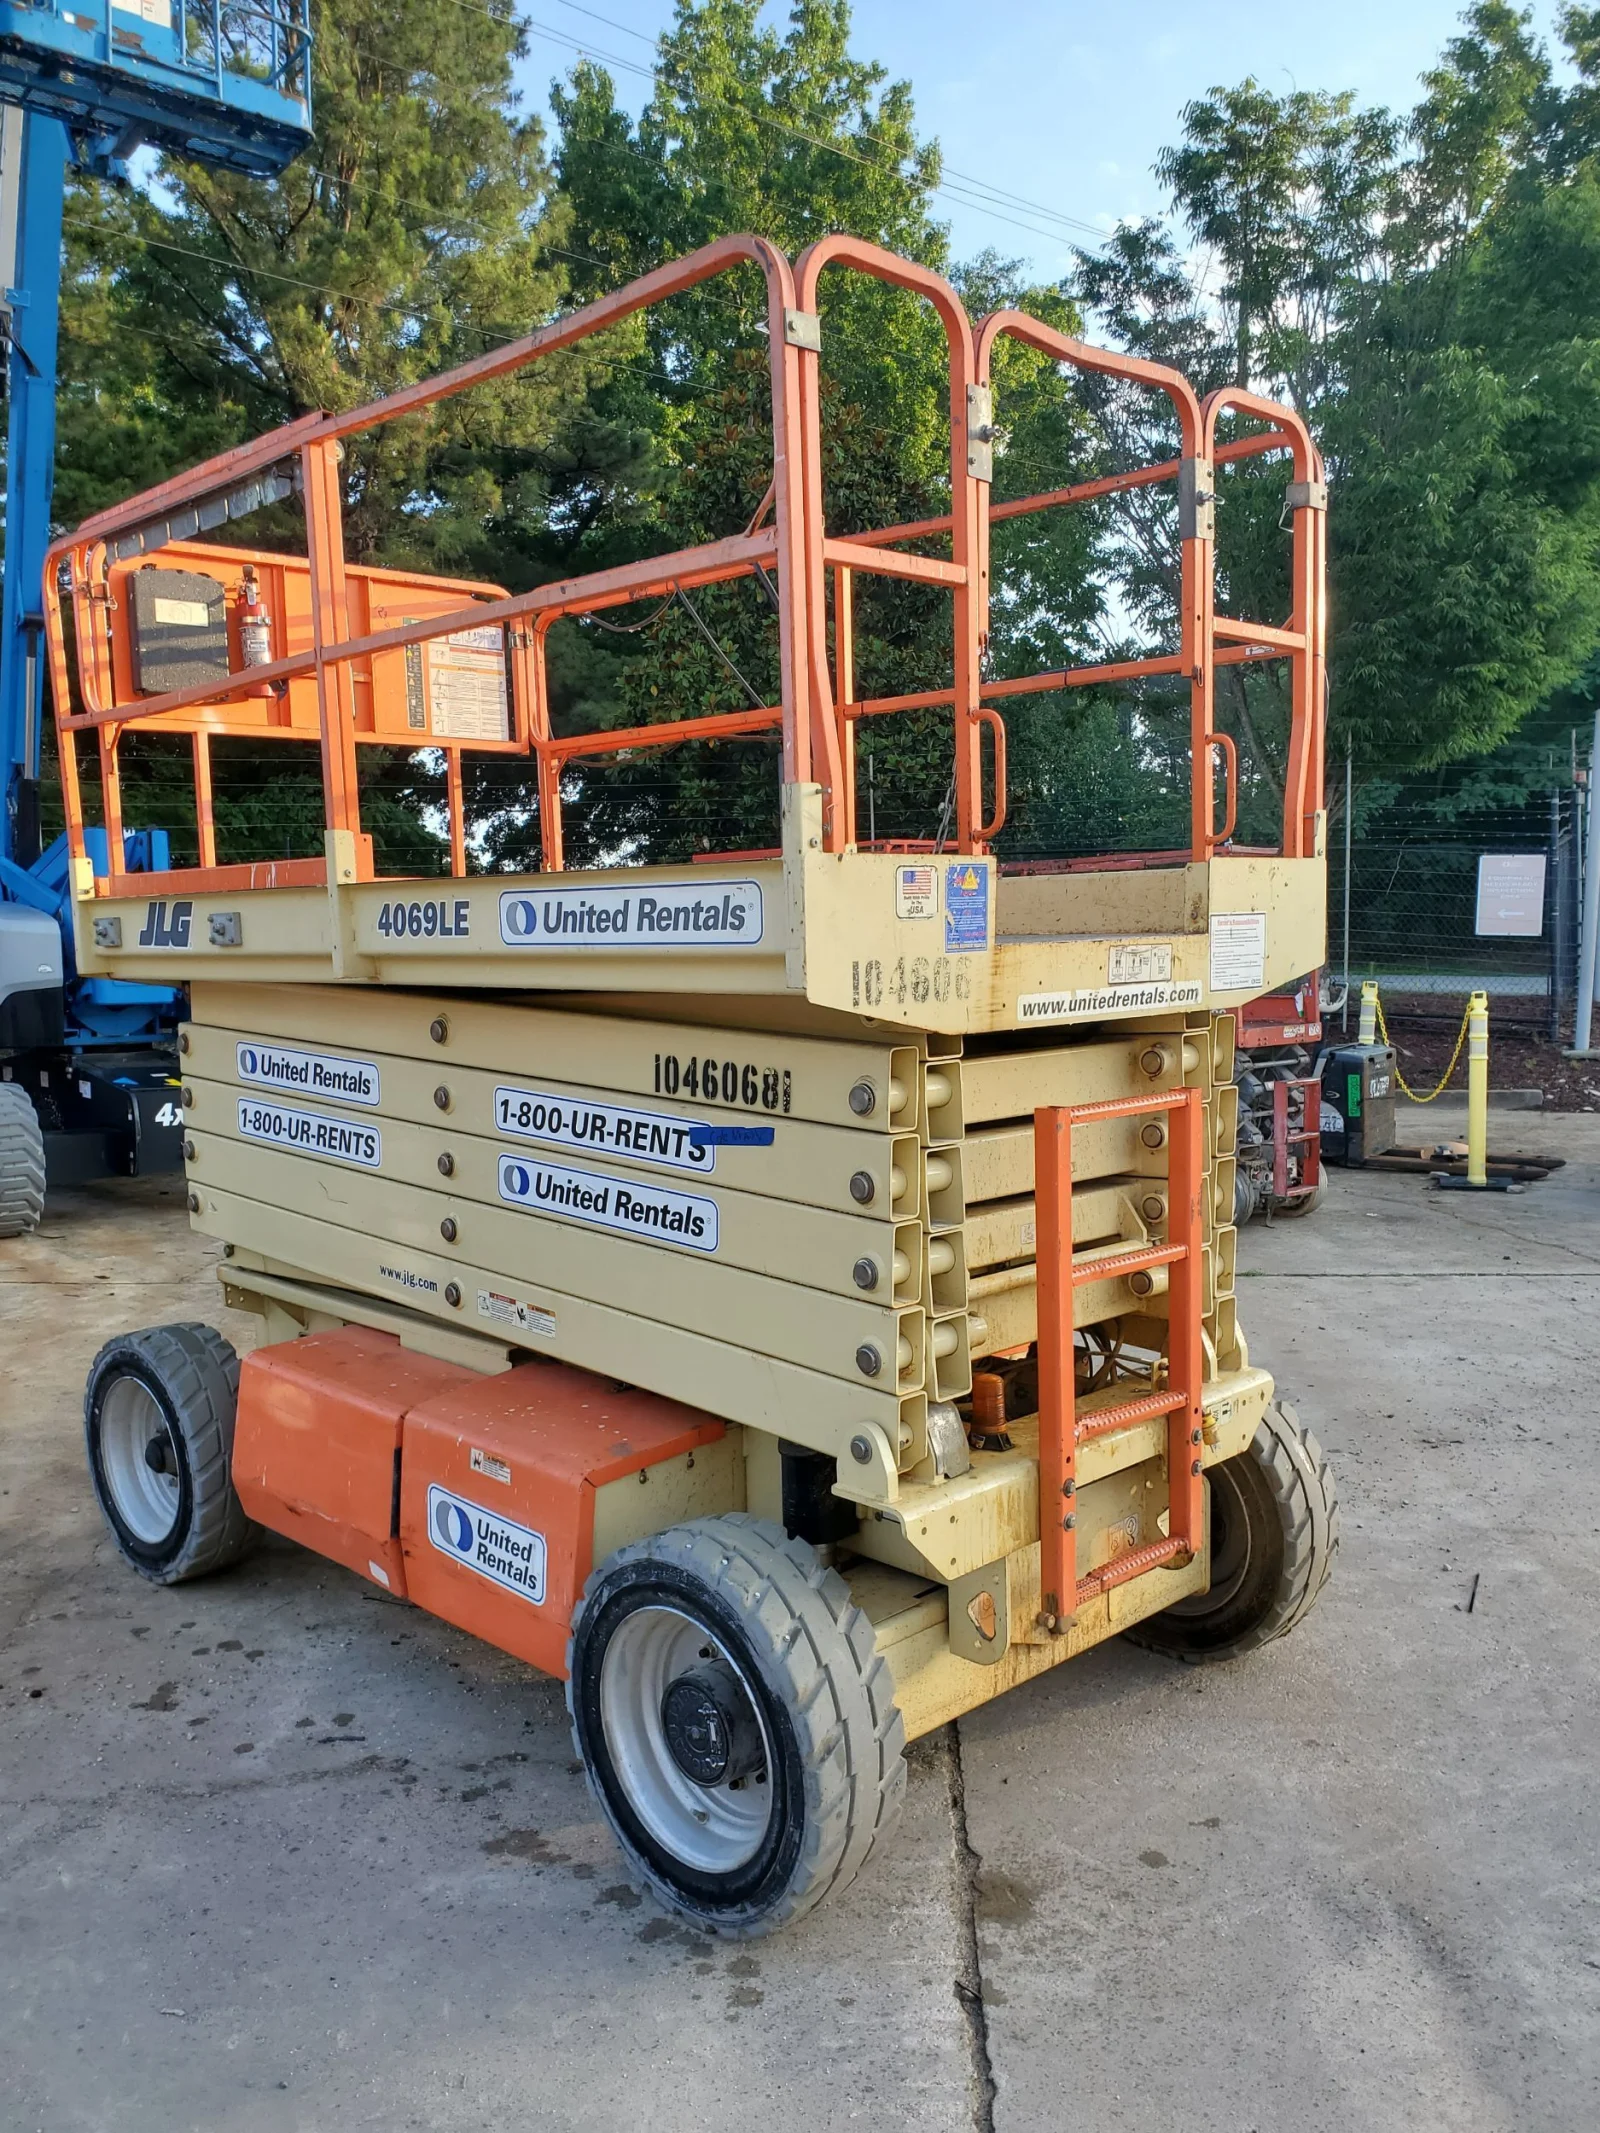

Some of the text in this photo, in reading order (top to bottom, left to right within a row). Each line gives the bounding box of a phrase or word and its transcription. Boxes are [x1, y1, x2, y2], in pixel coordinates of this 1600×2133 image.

[138, 901, 194, 948] JLG
[377, 900, 470, 938] 4069LE
[543, 894, 746, 934] United Rentals
[910, 905, 924, 914] USA
[1022, 986, 1199, 1017] www.unitedrentals.com
[260, 1053, 372, 1096] United Rentals
[241, 1107, 376, 1160] 1-800-UR-RENTS
[535, 1171, 705, 1238] United Rentals
[379, 1264, 438, 1293] www.jlg.com
[477, 1518, 533, 1564] United
[476, 1542, 538, 1591] Rentals
